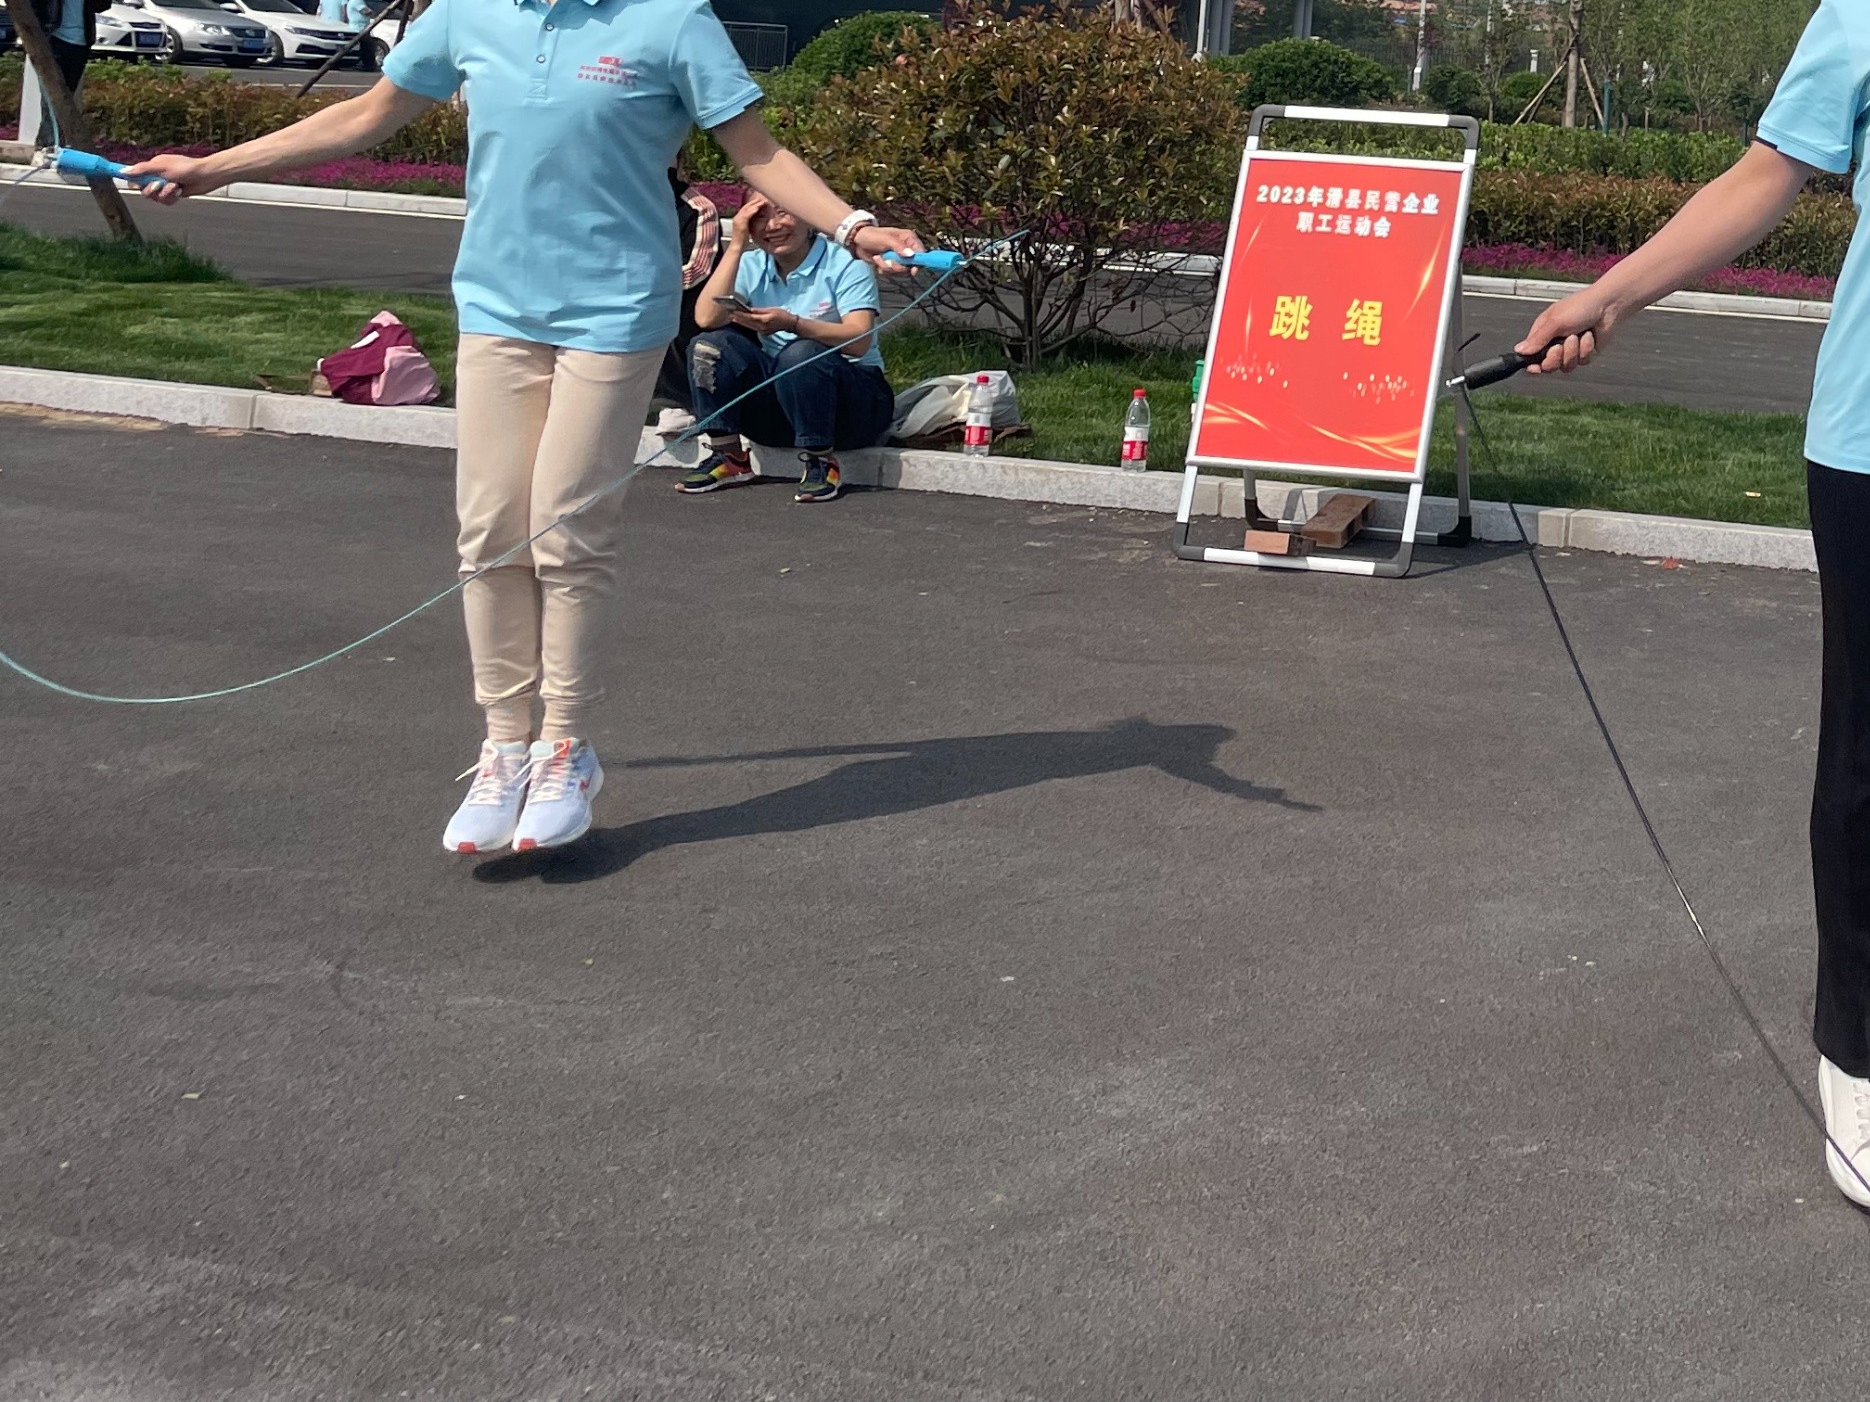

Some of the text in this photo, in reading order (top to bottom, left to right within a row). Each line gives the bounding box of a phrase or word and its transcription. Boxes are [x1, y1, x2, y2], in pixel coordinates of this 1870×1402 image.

[1256, 184, 1440, 215] 2023年滑县民营企业
[1296, 211, 1392, 238] 职工运动会
